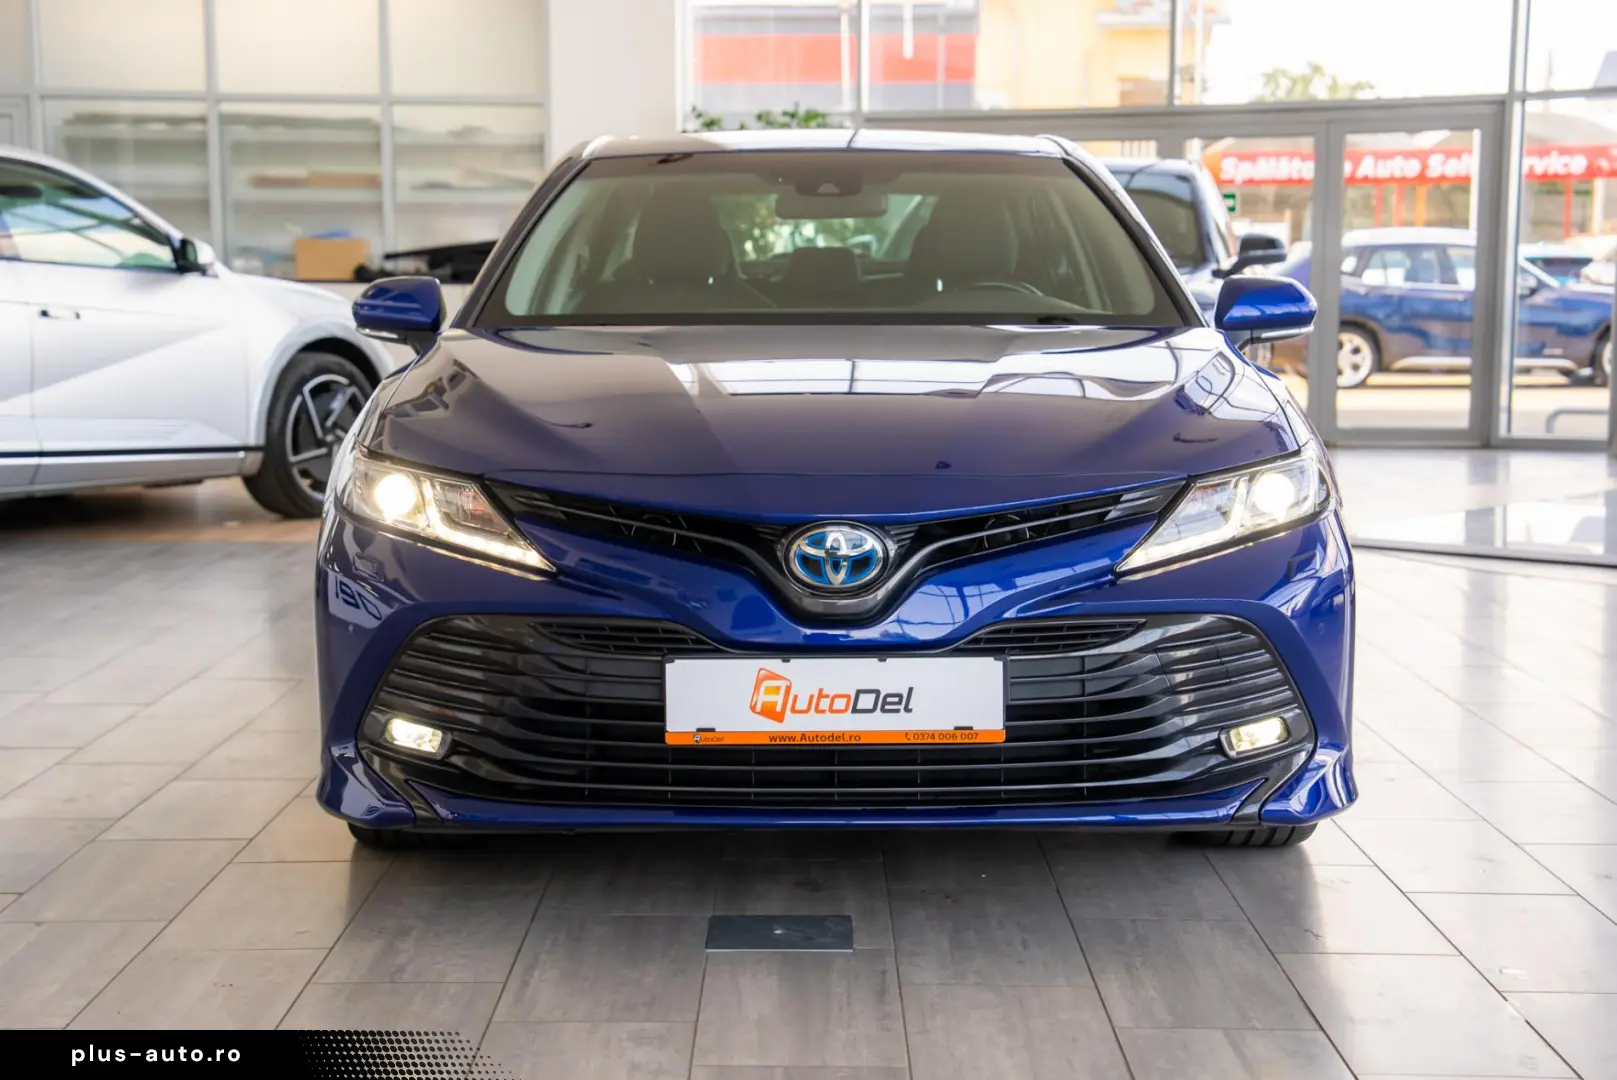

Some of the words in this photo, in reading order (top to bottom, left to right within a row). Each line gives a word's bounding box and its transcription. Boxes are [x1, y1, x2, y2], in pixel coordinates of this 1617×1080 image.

[1355, 154, 1422, 179] Auto
[1425, 152, 1473, 178] Sel
[751, 673, 914, 719] AutoDel
[768, 733, 861, 743] www.Autodel.ro
[912, 731, 936, 741] 0374
[938, 731, 958, 741] 006
[960, 731, 979, 741] 007
